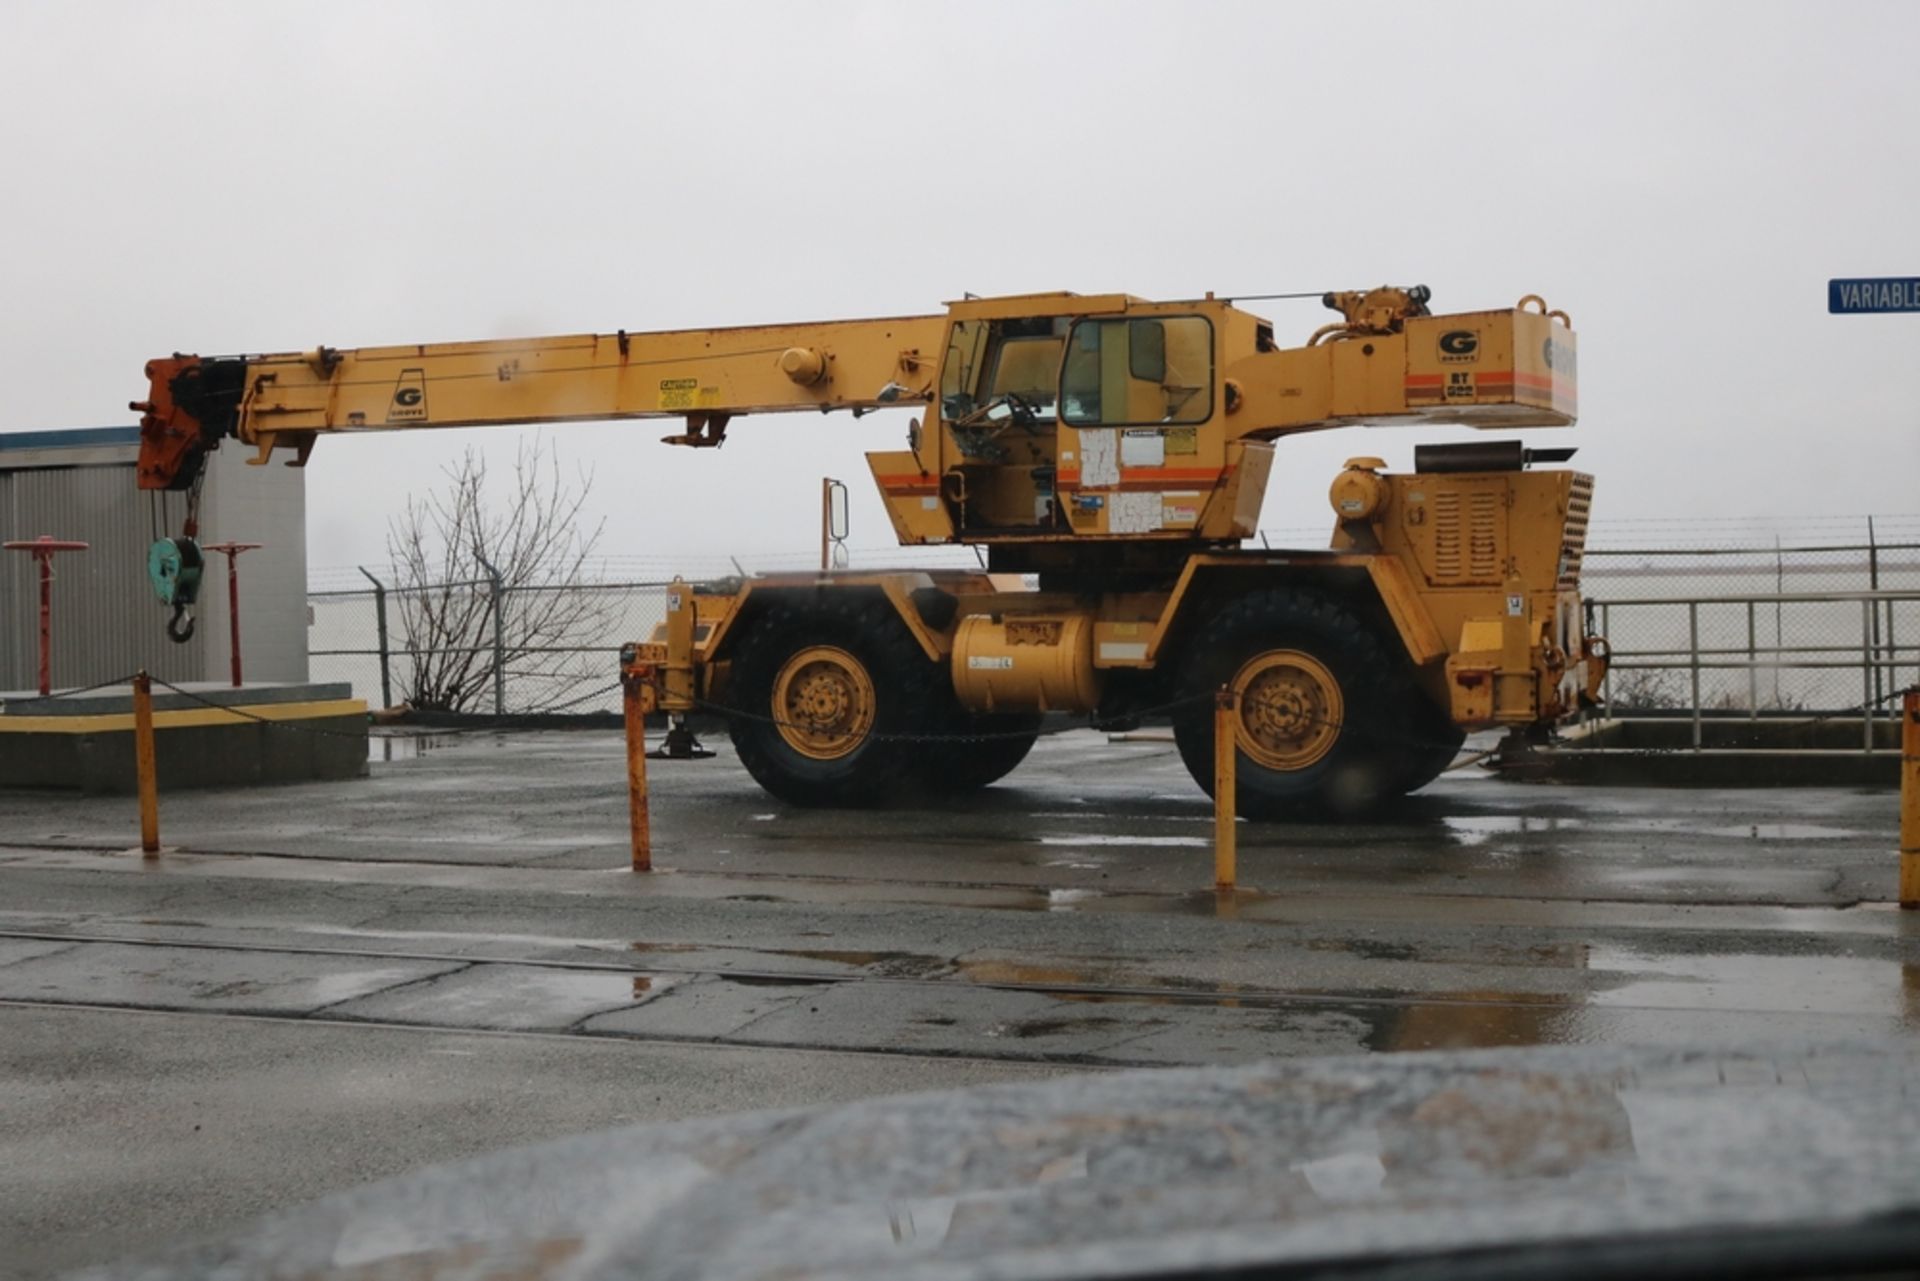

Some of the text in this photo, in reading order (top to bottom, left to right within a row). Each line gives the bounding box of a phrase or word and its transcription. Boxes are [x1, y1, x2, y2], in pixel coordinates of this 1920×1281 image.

[1839, 282, 1920, 308] VARIABLE
[1440, 330, 1477, 354] G
[395, 388, 421, 406] G
